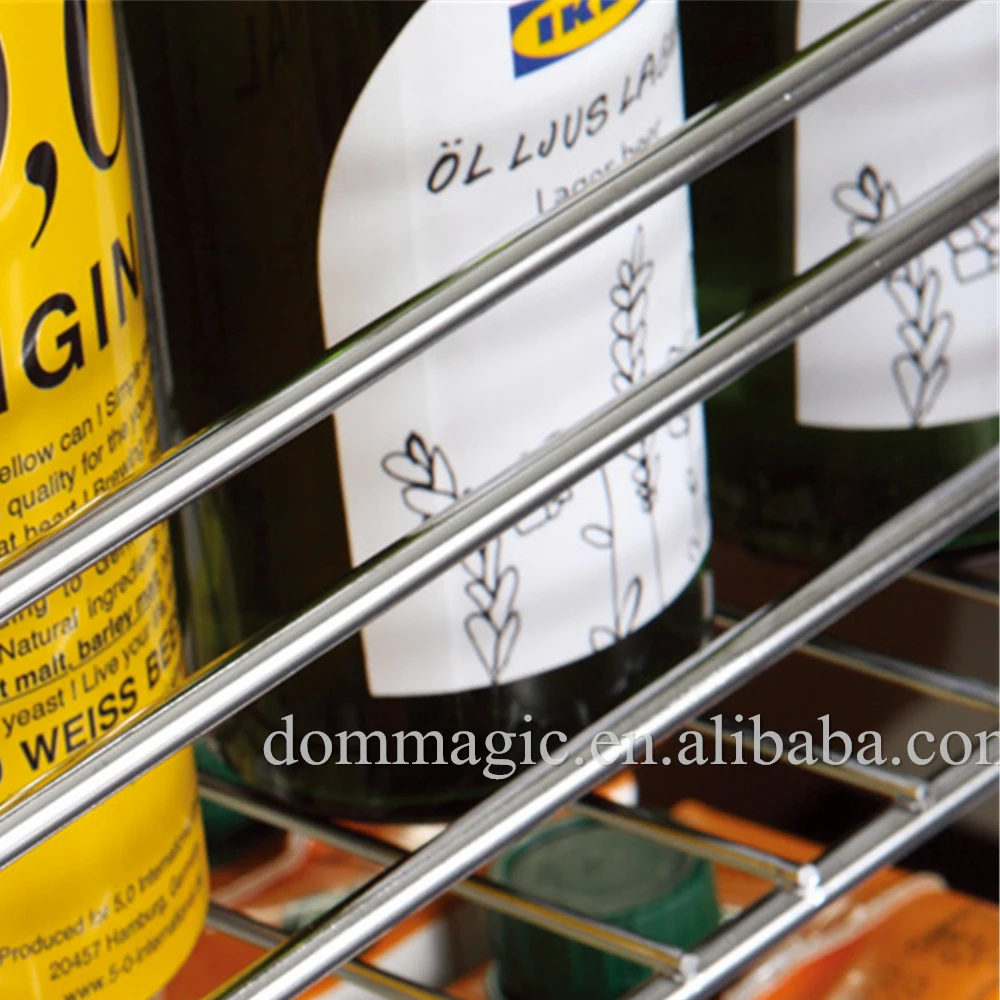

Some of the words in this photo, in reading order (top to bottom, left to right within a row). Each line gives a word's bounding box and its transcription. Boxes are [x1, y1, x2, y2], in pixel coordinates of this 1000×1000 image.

[426, 138, 493, 194] ÖL
[508, 92, 610, 171] LJUS
[60, 415, 94, 452] can
[7, 465, 76, 520] quality
[81, 445, 104, 476] for
[15, 651, 74, 693] malt,
[77, 606, 133, 661] barley
[1, 687, 66, 739] yeast
[81, 656, 119, 694] Live
[19, 677, 138, 773] WEISS
